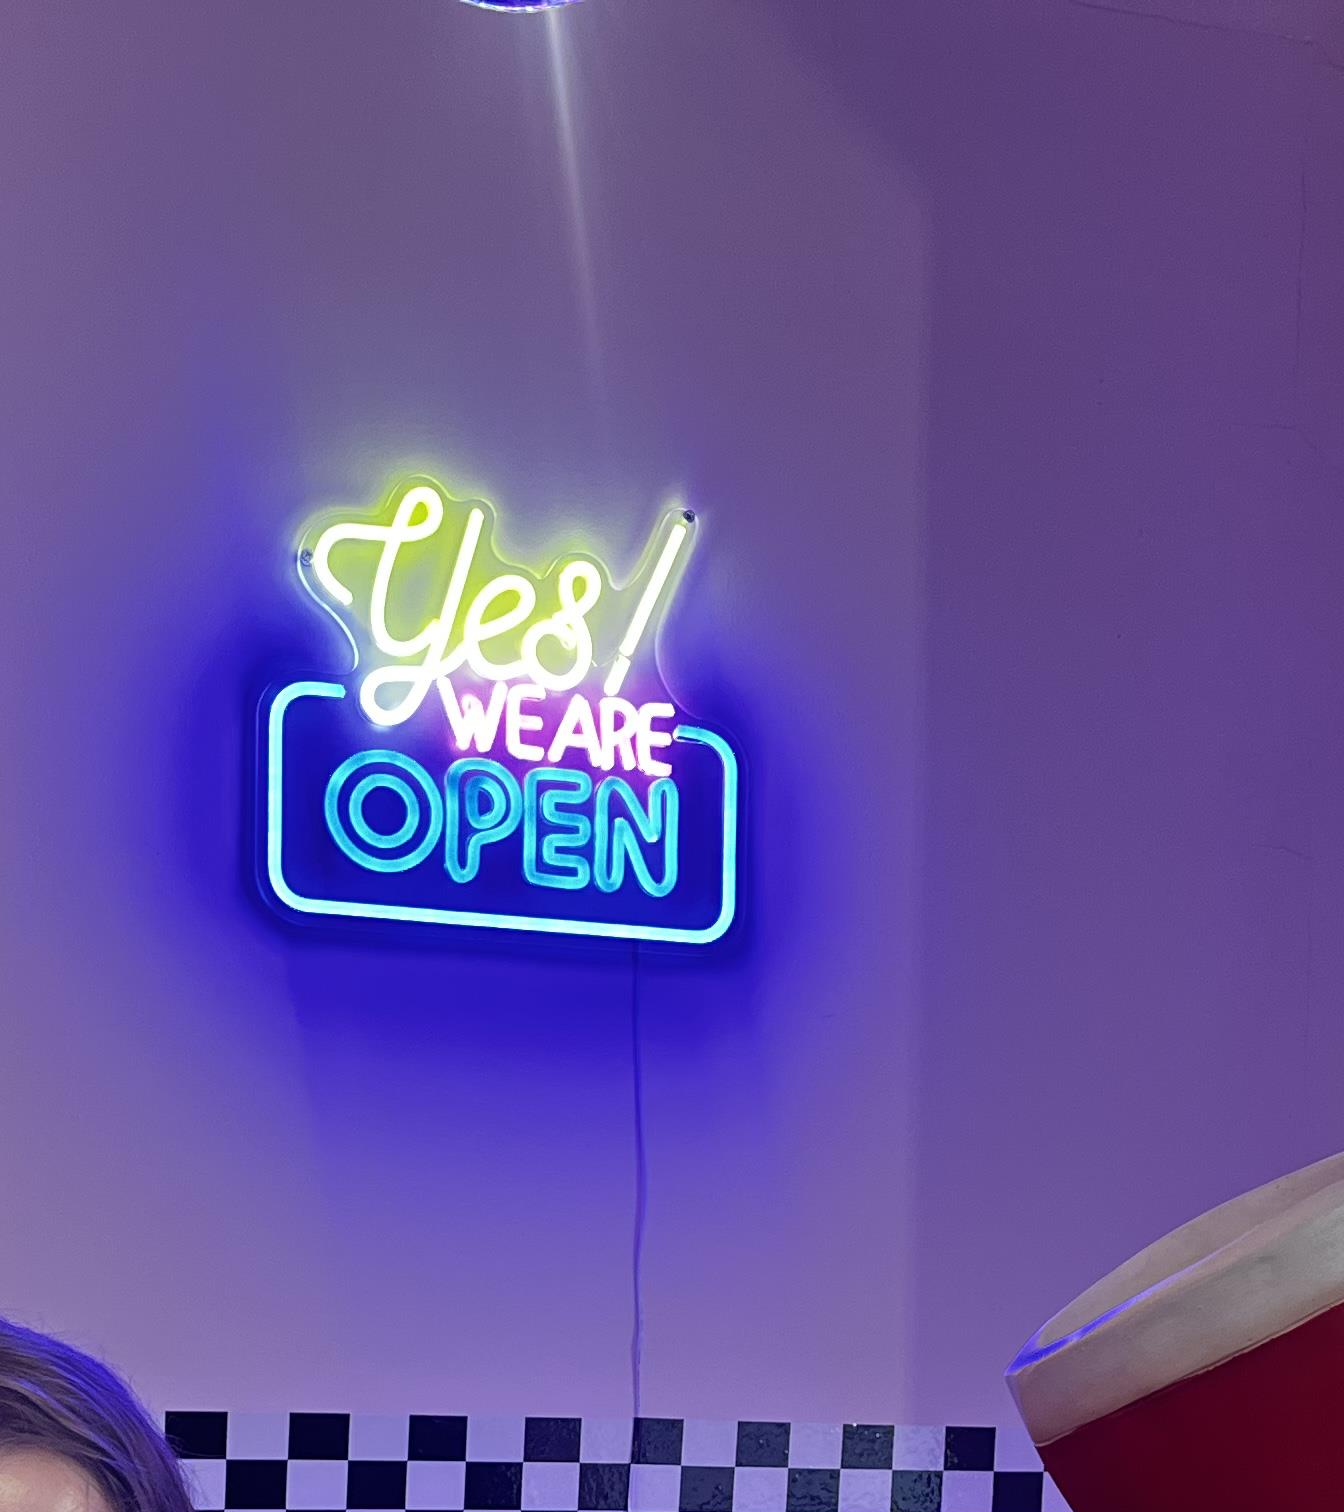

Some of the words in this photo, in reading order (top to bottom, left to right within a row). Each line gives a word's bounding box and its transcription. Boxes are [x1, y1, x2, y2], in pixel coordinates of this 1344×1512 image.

[312, 485, 687, 727] Yes!
[436, 675, 546, 762] WE
[547, 693, 676, 777] ARE
[324, 749, 680, 898] OPEN
